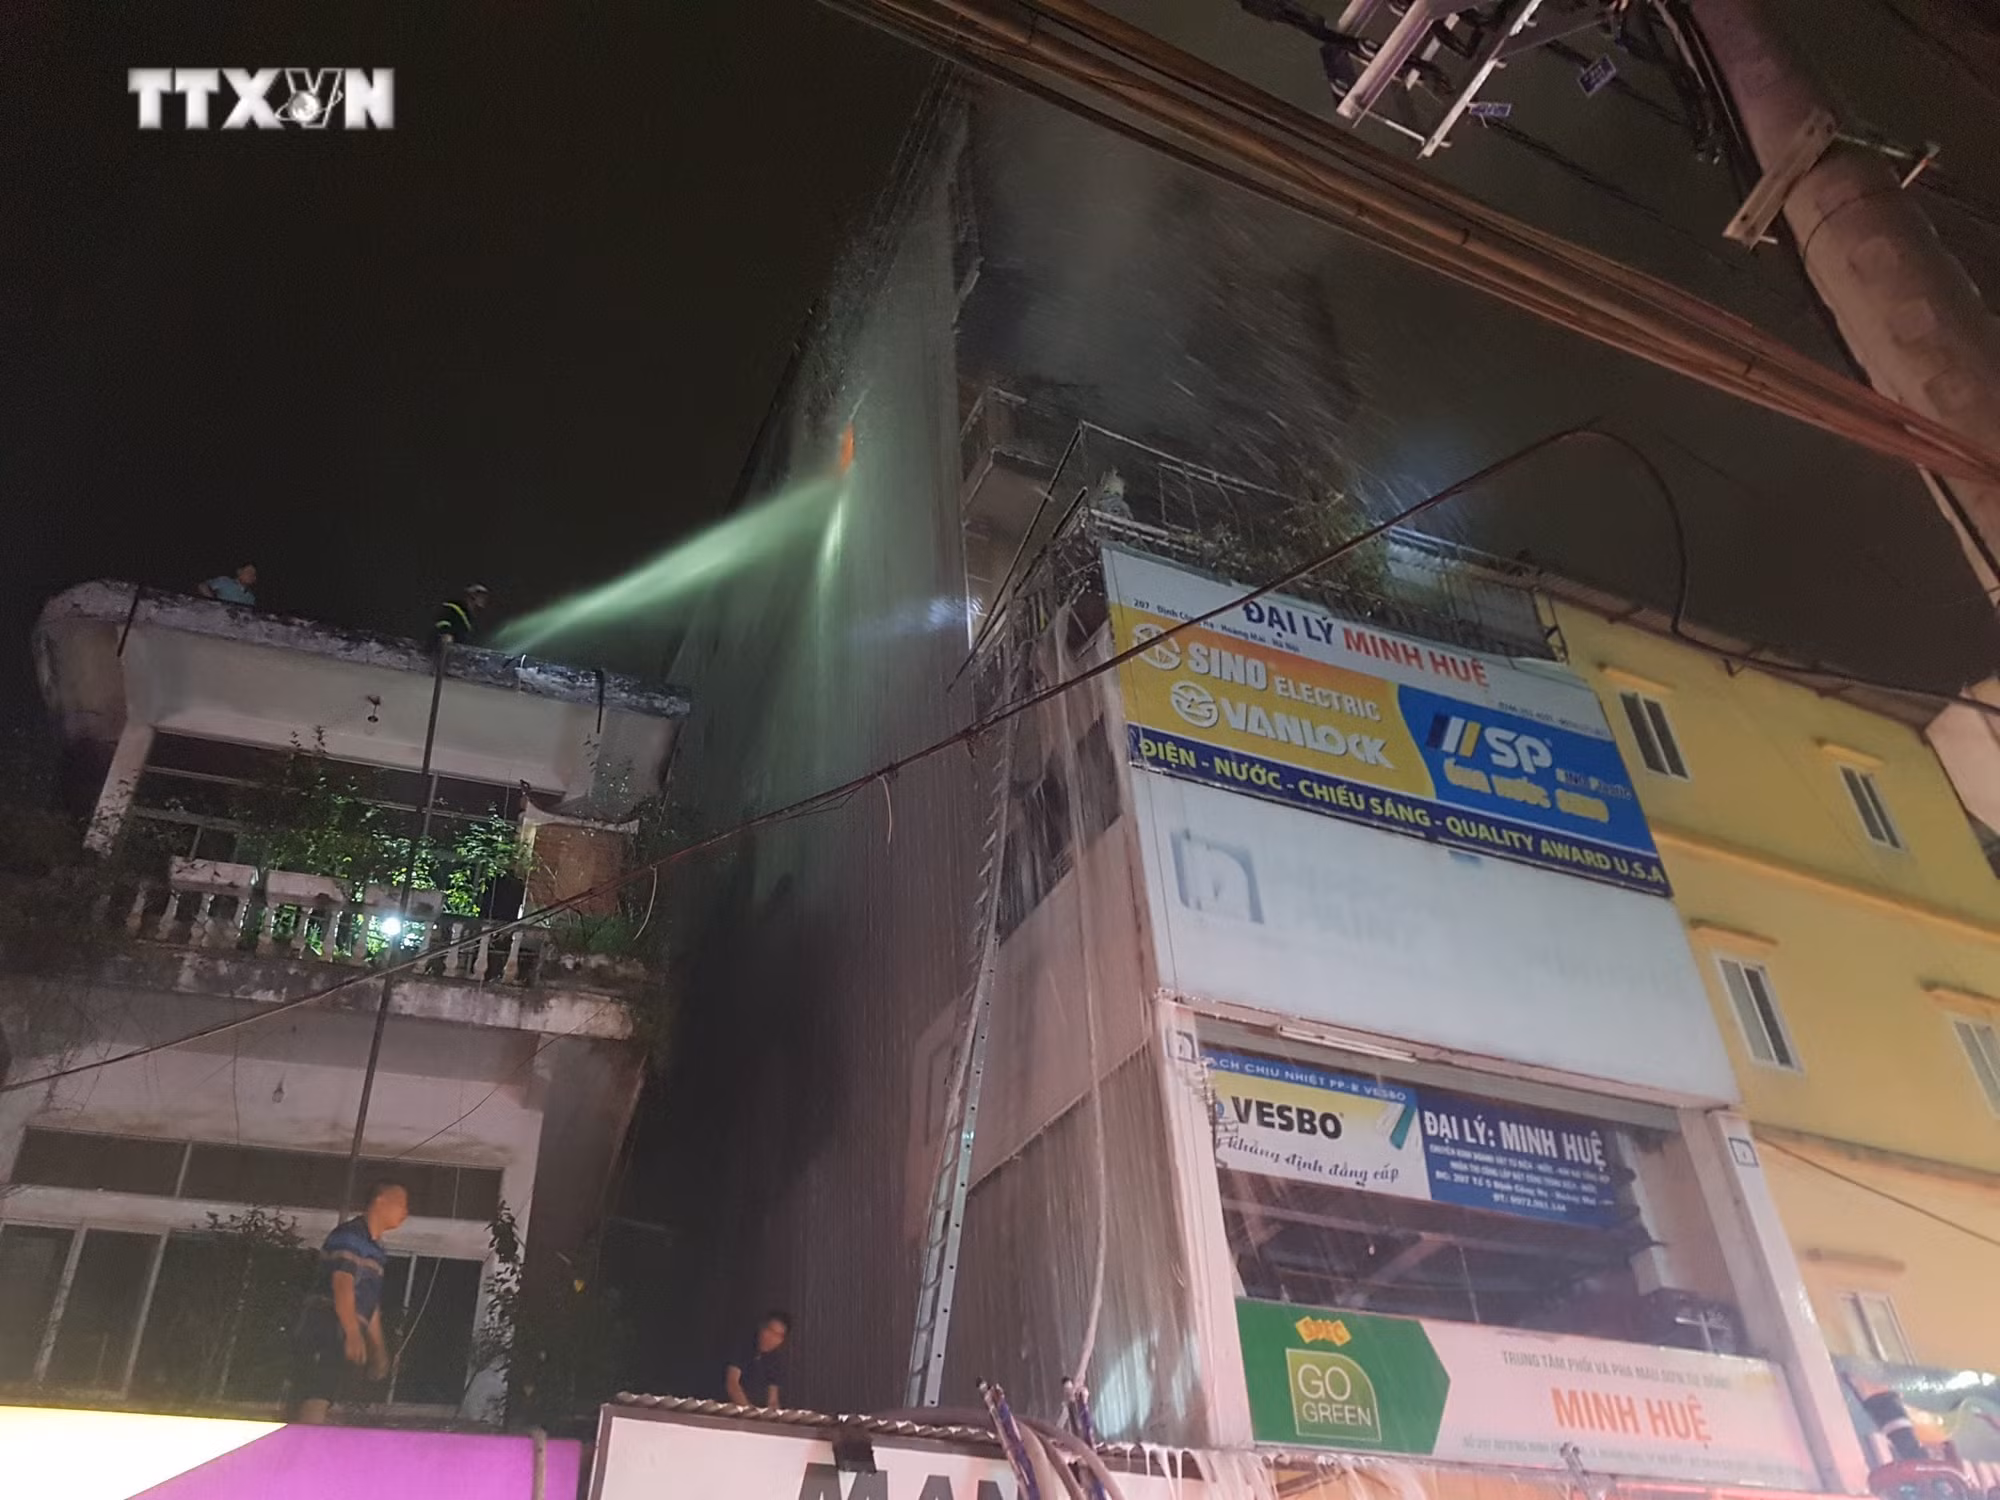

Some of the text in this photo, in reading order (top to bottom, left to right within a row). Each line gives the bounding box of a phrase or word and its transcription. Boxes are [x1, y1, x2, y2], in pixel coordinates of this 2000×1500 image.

[1243, 600, 1297, 638] ĐẠI
[1303, 614, 1334, 645] LÝ
[1343, 627, 1424, 671] MINH
[1188, 641, 1381, 722] SINO ELECTRIC
[1220, 697, 1394, 769] VANLOCK
[1484, 726, 1553, 774] SP
[1139, 739, 1196, 769] ĐIỆN
[1214, 756, 1281, 790] NƯỚC
[1370, 795, 1430, 826] SÁNG
[1446, 815, 1534, 853] QUALITY
[1540, 838, 1611, 871] AWARD
[1231, 1095, 1342, 1140] VESBO
[1363, 1085, 1407, 1101] VESBO
[1424, 1111, 1459, 1144] ĐẠI
[1500, 1120, 1558, 1159] MINH
[1562, 1130, 1608, 1173] HUỆ
[1298, 1363, 1351, 1401] GO
[1302, 1402, 1372, 1427] GREEN
[1550, 1387, 1712, 1450] MINH HUỆ
